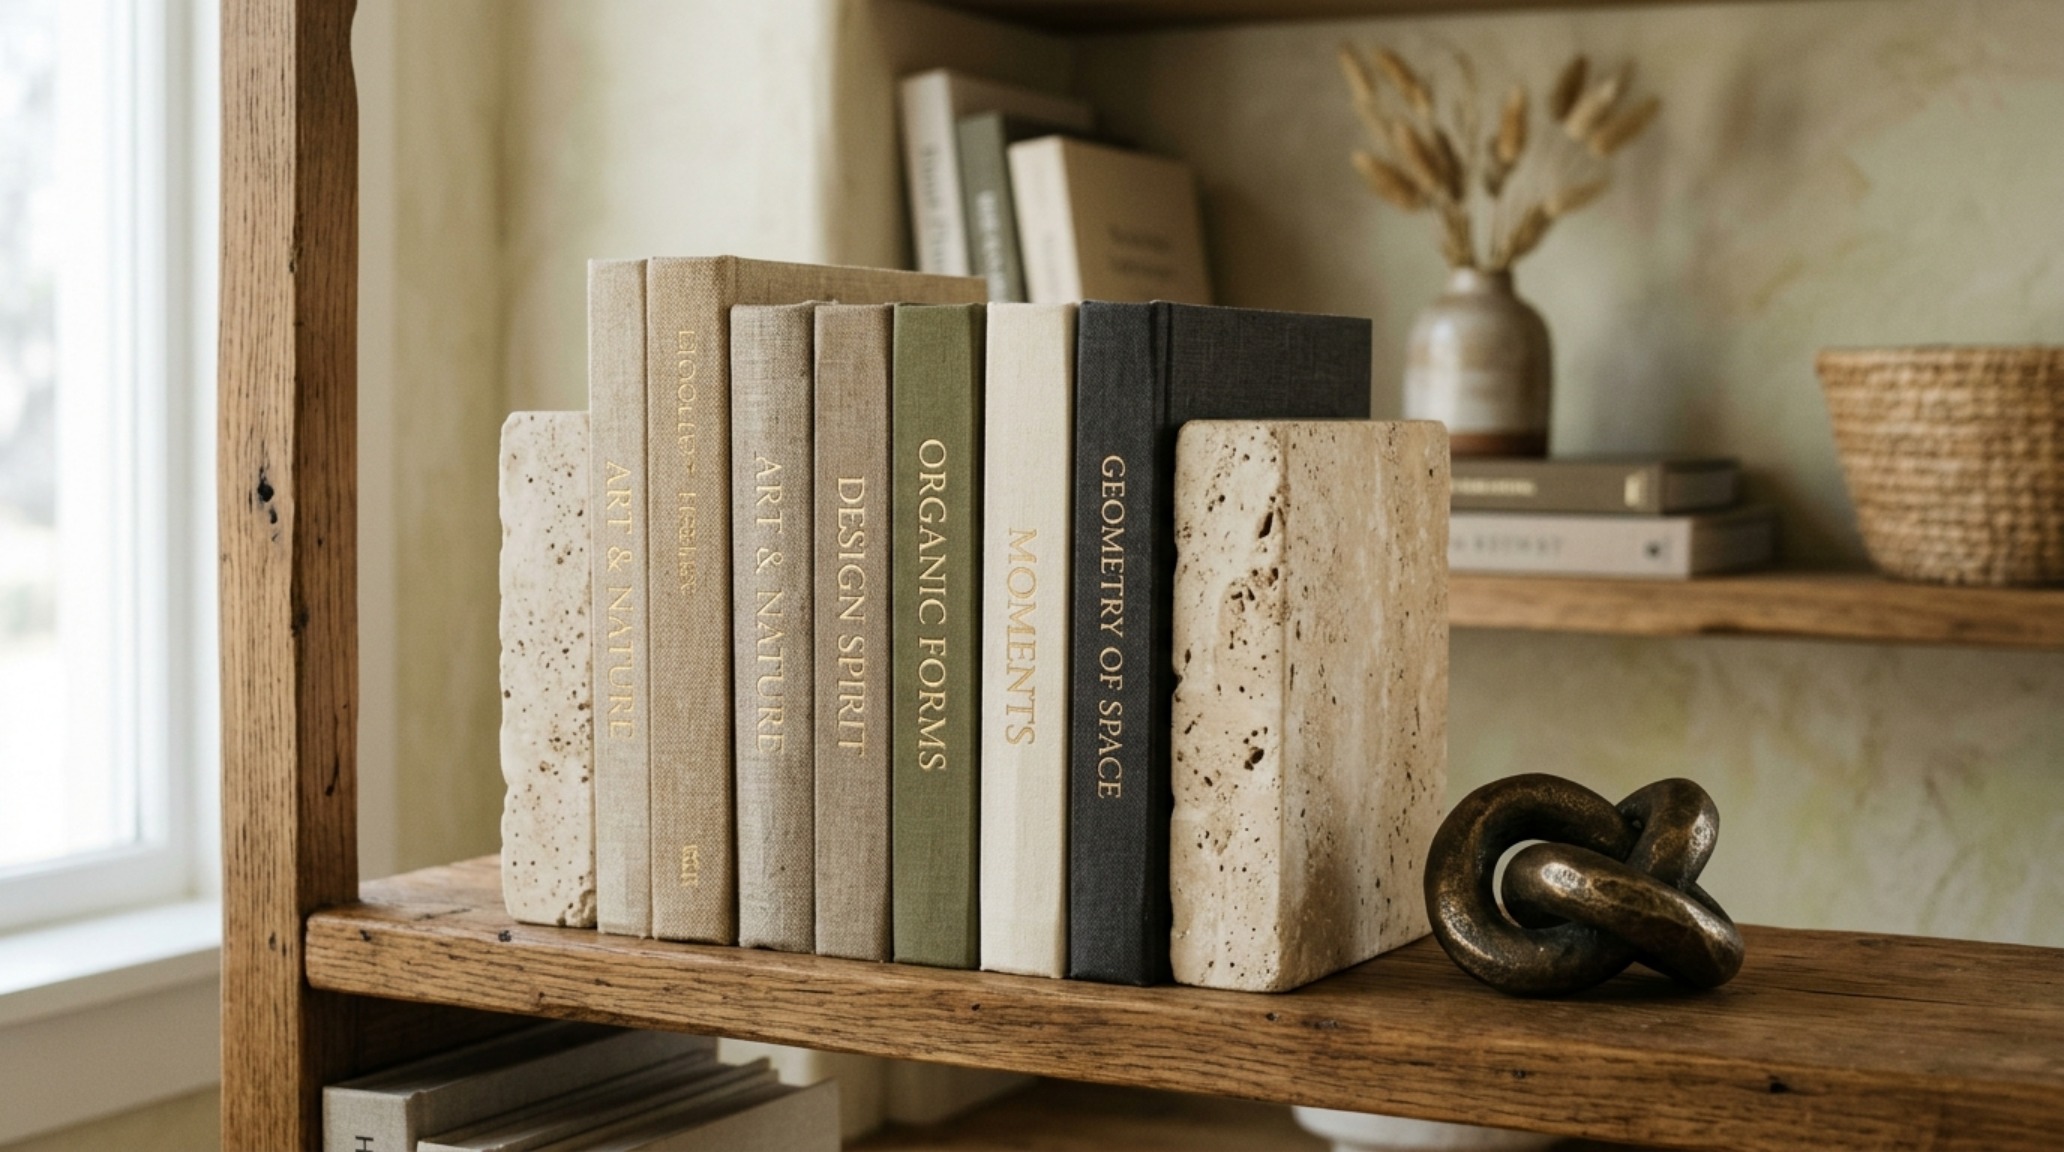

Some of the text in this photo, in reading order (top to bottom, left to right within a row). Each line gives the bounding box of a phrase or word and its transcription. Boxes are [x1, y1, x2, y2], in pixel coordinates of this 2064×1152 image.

[605, 460, 634, 740] ART & NATURE
[755, 456, 784, 755] ART & NATURE
[837, 476, 866, 758] DESIGN SPIRIT
[917, 438, 947, 772] ORGANIC FORMS
[1005, 527, 1037, 746] MOMENTS
[1096, 454, 1127, 800] GEOMETRY OF SPACE
